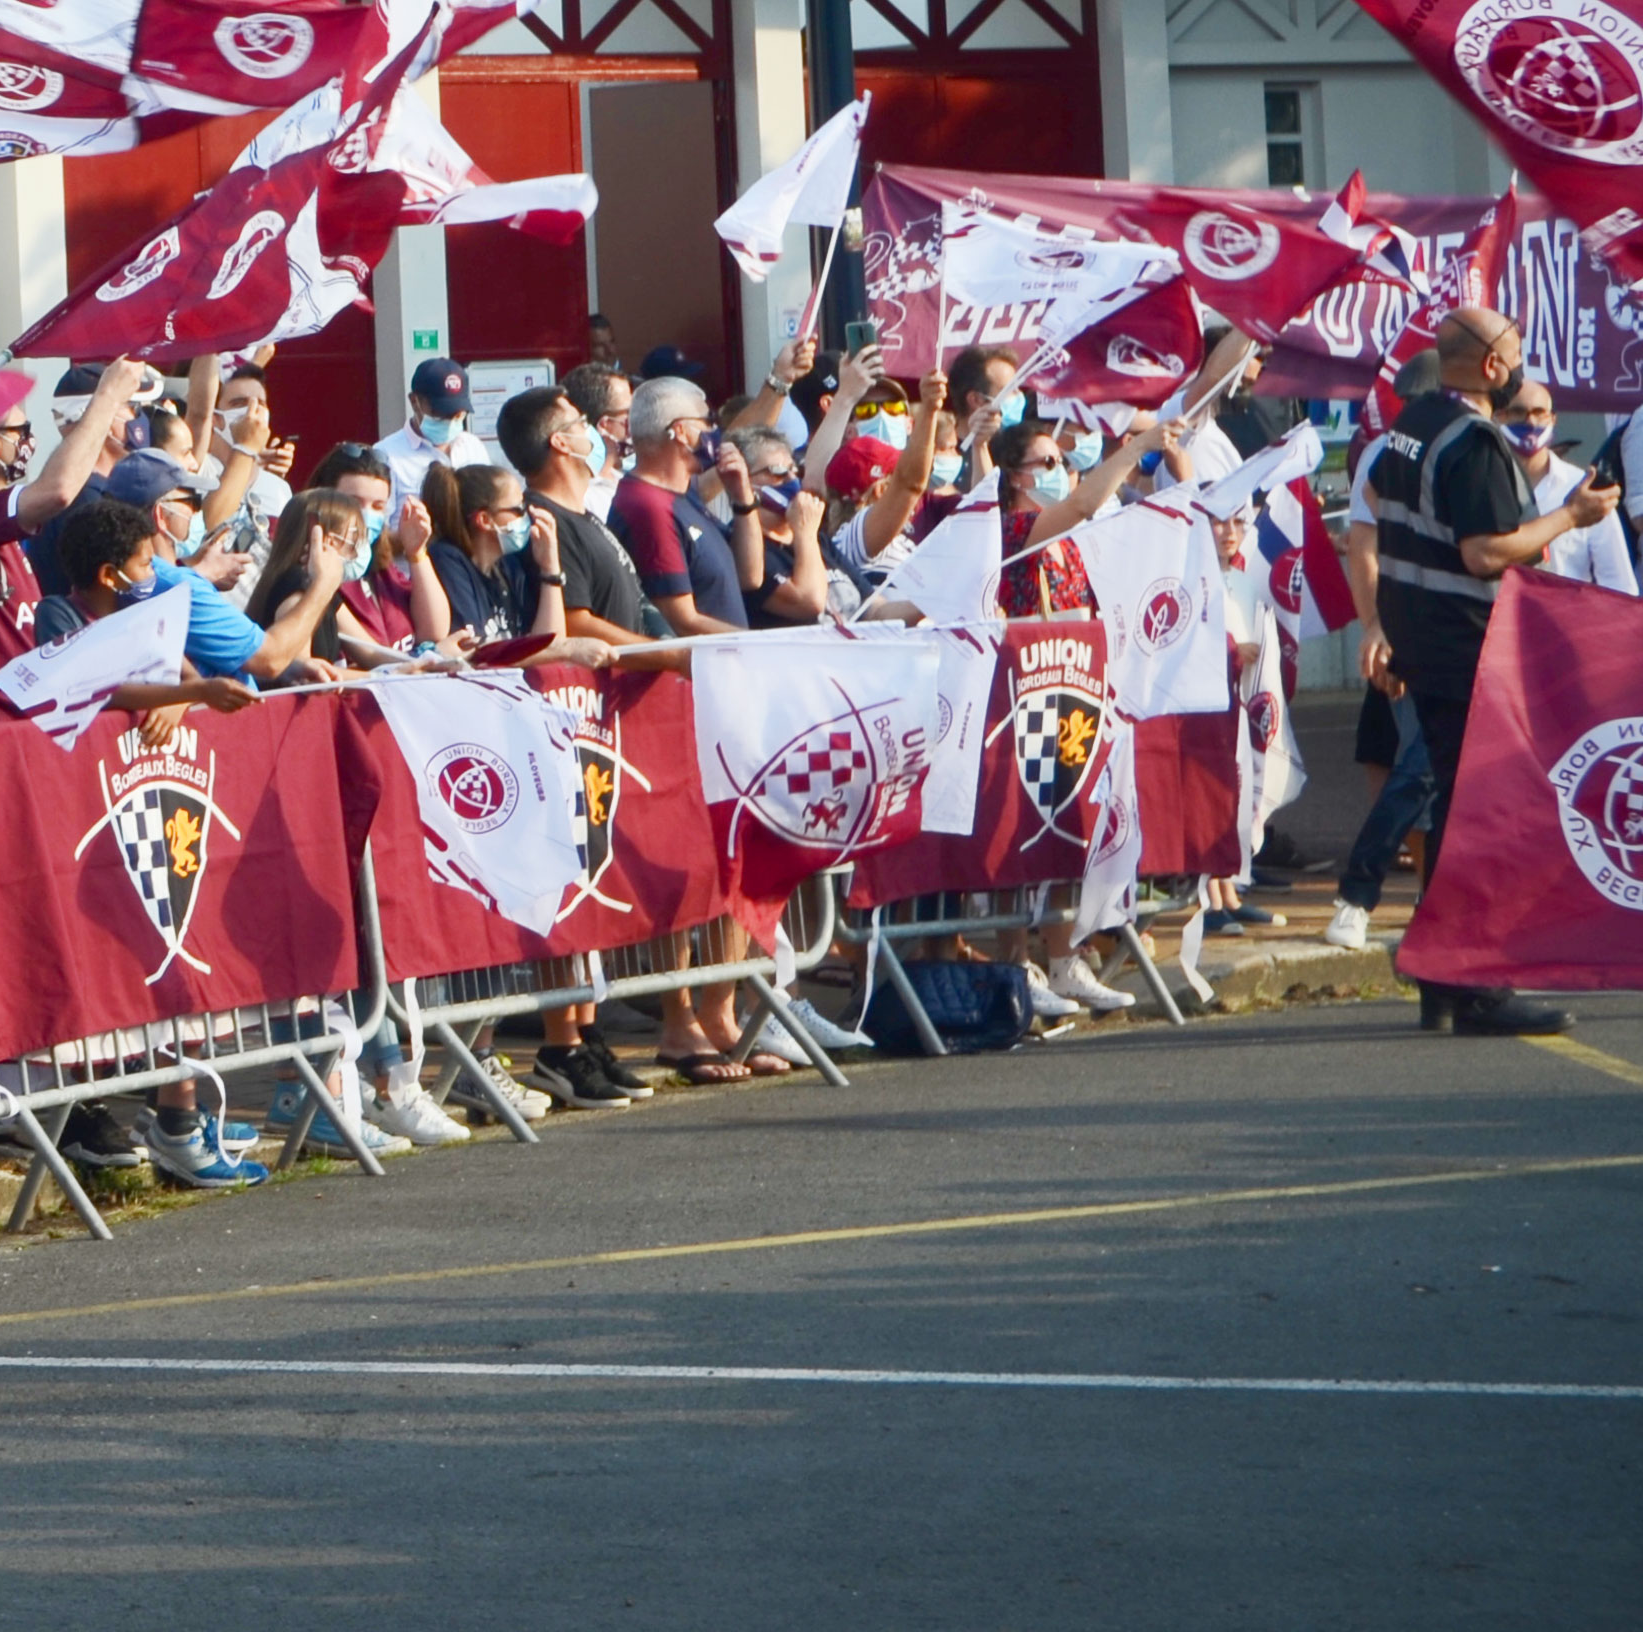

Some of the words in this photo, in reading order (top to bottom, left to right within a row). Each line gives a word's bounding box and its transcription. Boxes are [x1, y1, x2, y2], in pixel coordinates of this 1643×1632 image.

[1577, 307, 1596, 389] .COM
[1020, 637, 1093, 673] UNION
[542, 685, 604, 720] NION
[111, 759, 166, 797] BORDEAUX
[164, 754, 208, 789] BEGLES
